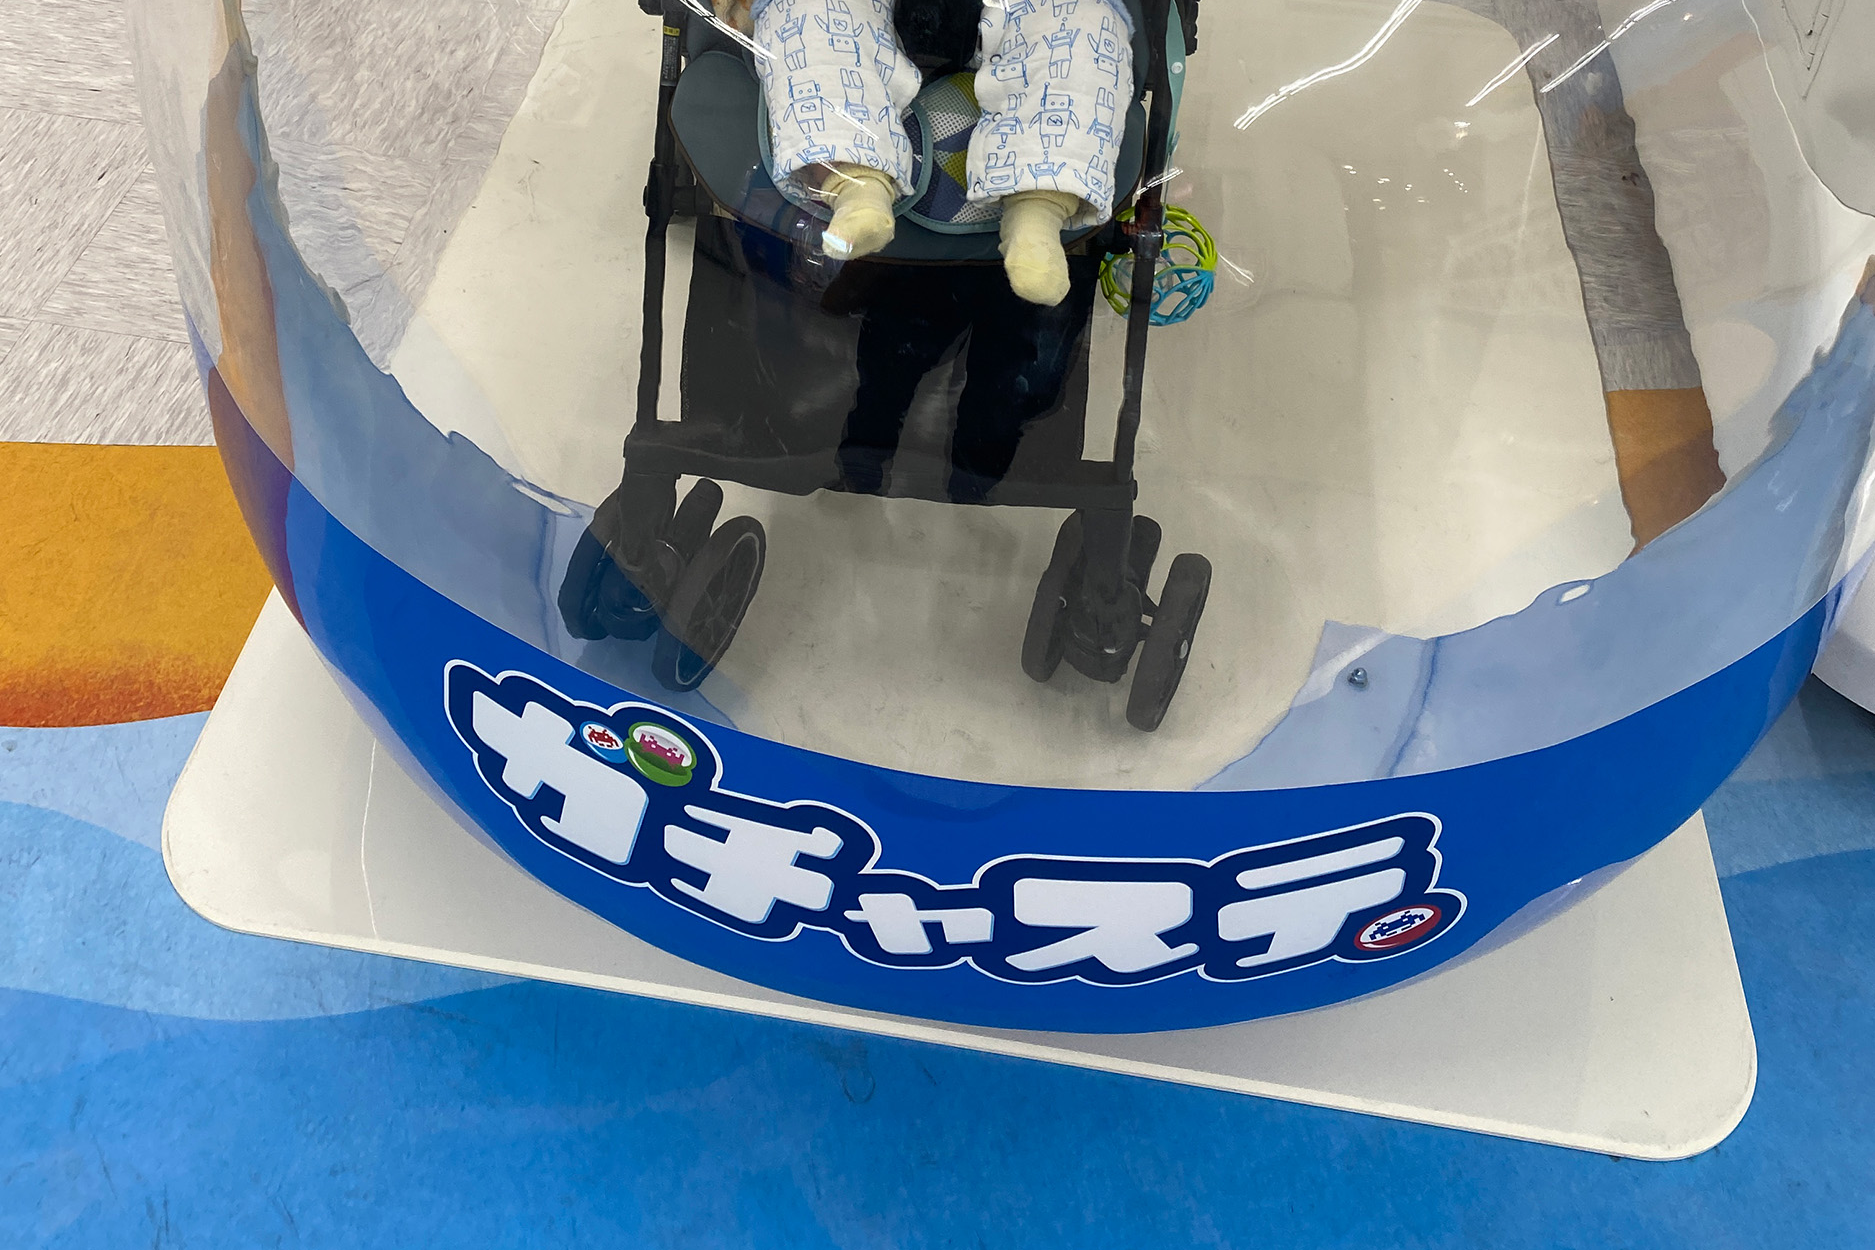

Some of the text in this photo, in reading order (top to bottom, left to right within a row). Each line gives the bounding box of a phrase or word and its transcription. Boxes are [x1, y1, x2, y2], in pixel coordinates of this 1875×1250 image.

[470, 688, 1408, 975] ガチャステ
